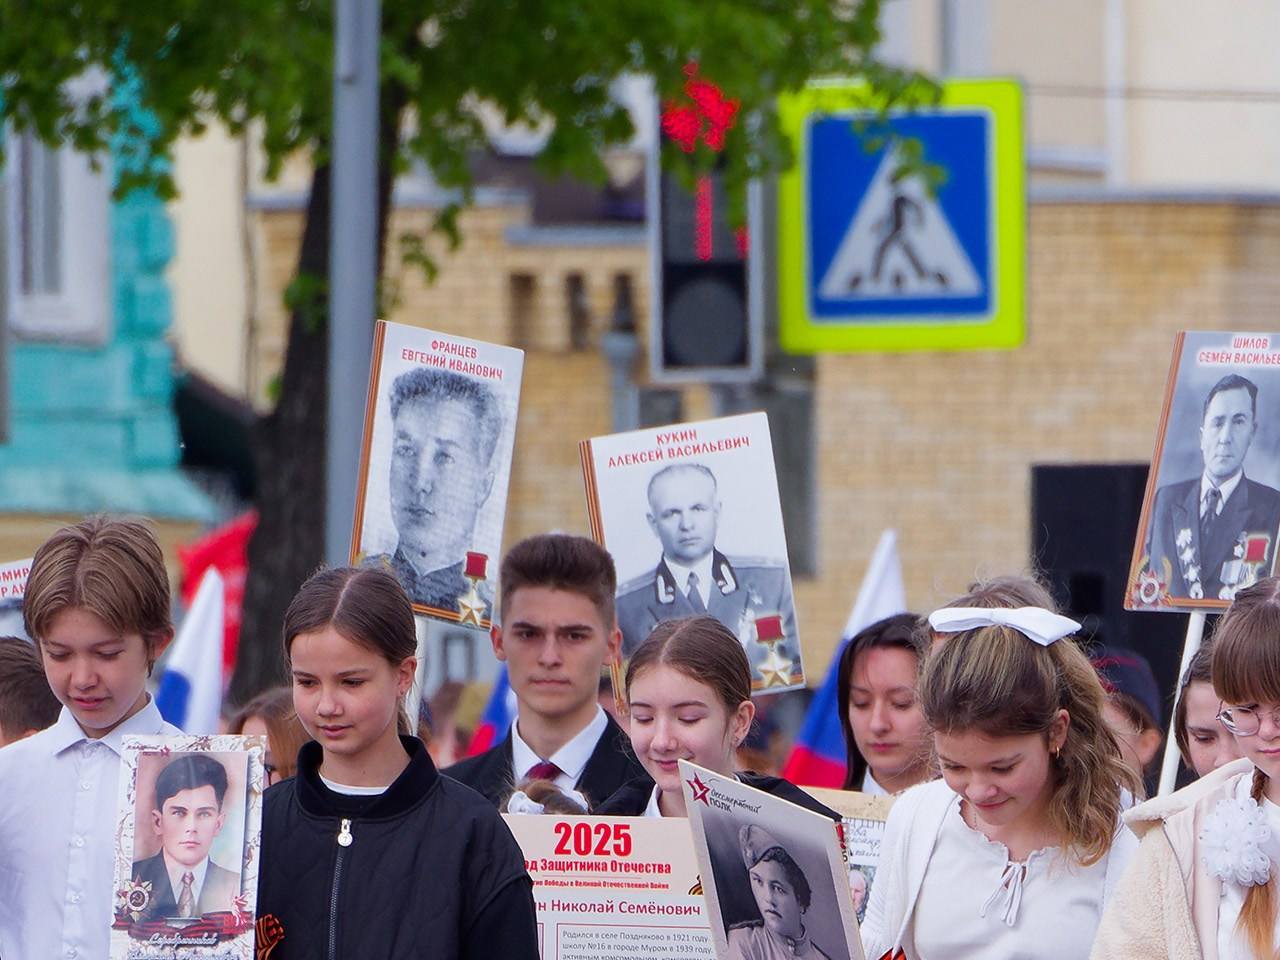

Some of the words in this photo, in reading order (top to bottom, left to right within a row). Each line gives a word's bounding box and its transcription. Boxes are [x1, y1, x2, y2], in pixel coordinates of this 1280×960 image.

[431, 339, 477, 359] ФРАНЦЕВ
[1233, 337, 1268, 349] ШИЛОВ
[401, 348, 446, 368] ЕВГЕНИЙ
[449, 358, 503, 380] ИВАНОВИЧ
[1199, 350, 1231, 363] СЕМЁН
[656, 429, 698, 446] КУКИН
[608, 447, 664, 468] АЛЕКСЕЙ
[668, 436, 750, 459] ВАСИЛЬЕВИЧ
[554, 822, 633, 857] 2025
[525, 860, 538, 872] од
[541, 858, 608, 873] Защитника
[610, 860, 671, 874] Отечества
[551, 899, 614, 913] Николай
[618, 900, 701, 915] Семёнович
[562, 931, 593, 940] Родился
[620, 932, 664, 941] Поздняково
[562, 943, 586, 951] школу
[587, 942, 606, 950] №16
[641, 944, 668, 953] Муром
[676, 945, 694, 953] 1939
